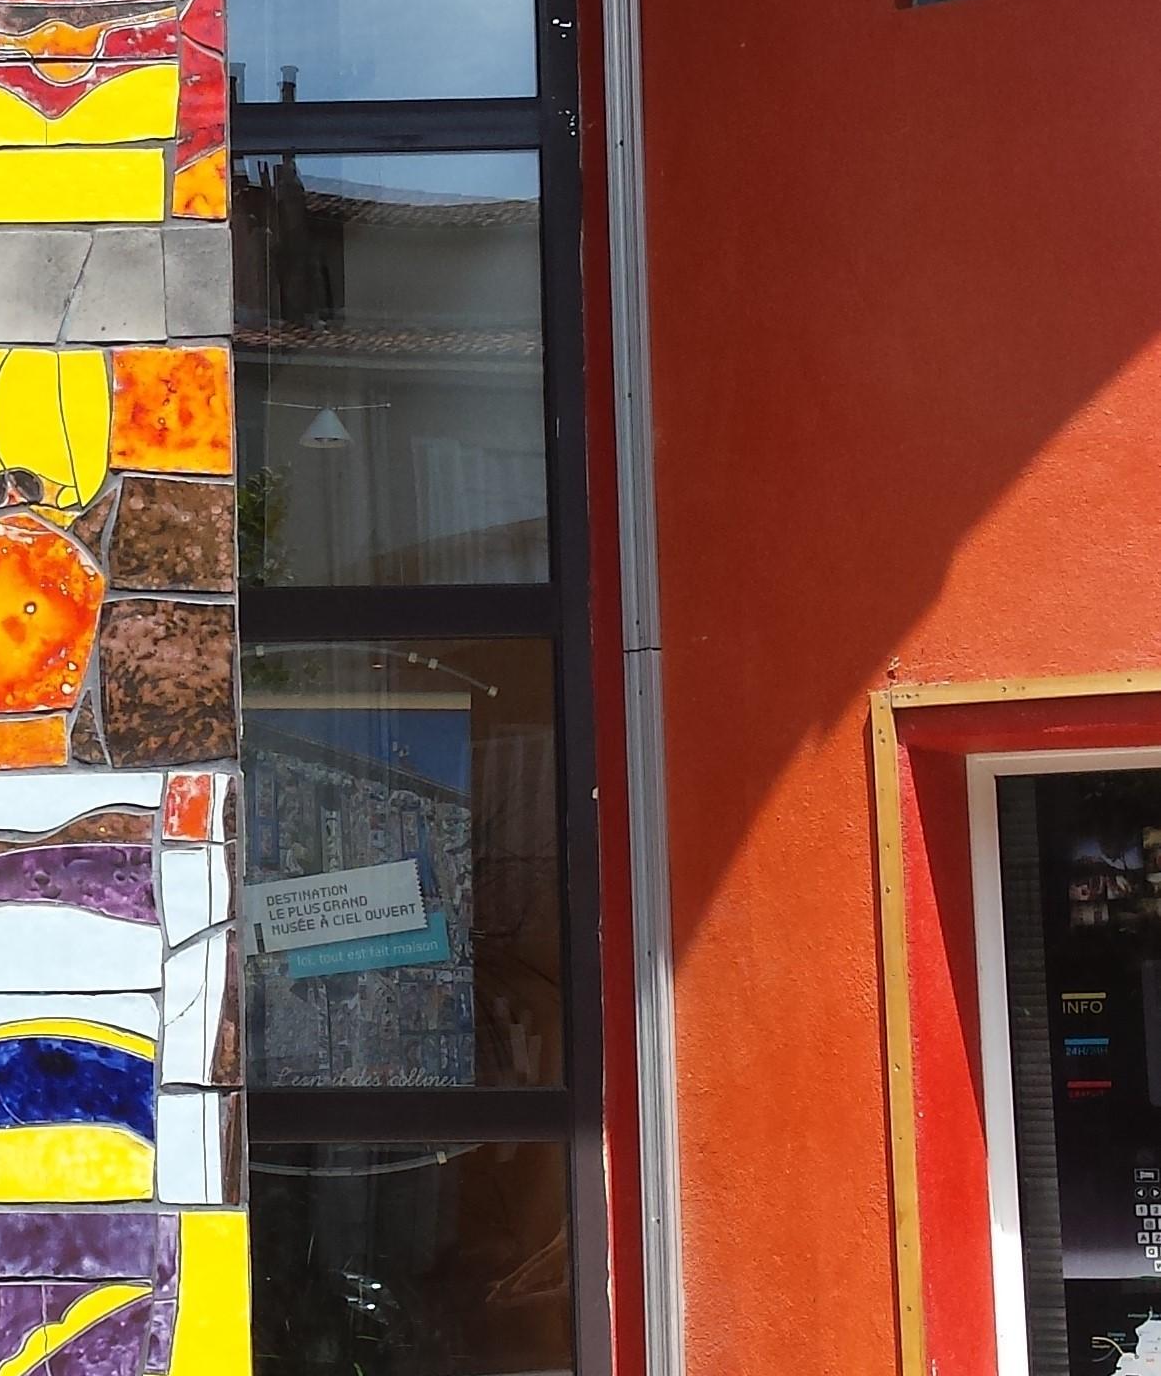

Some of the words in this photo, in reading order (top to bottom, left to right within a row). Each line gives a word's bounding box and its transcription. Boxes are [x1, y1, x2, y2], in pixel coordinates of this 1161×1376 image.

[266, 884, 348, 906] DESTINATION
[269, 908, 285, 921] LE
[288, 902, 321, 918] PLUS
[323, 895, 368, 912] GRAND
[272, 918, 315, 936] MUSÉE
[320, 914, 329, 928] À
[333, 912, 362, 926] CIEL
[365, 903, 416, 921] OUVERT
[319, 951, 344, 964] tout
[347, 948, 366, 961] est
[369, 945, 389, 958] fait
[393, 940, 438, 955] maison
[1062, 1000, 1104, 1014] INFO
